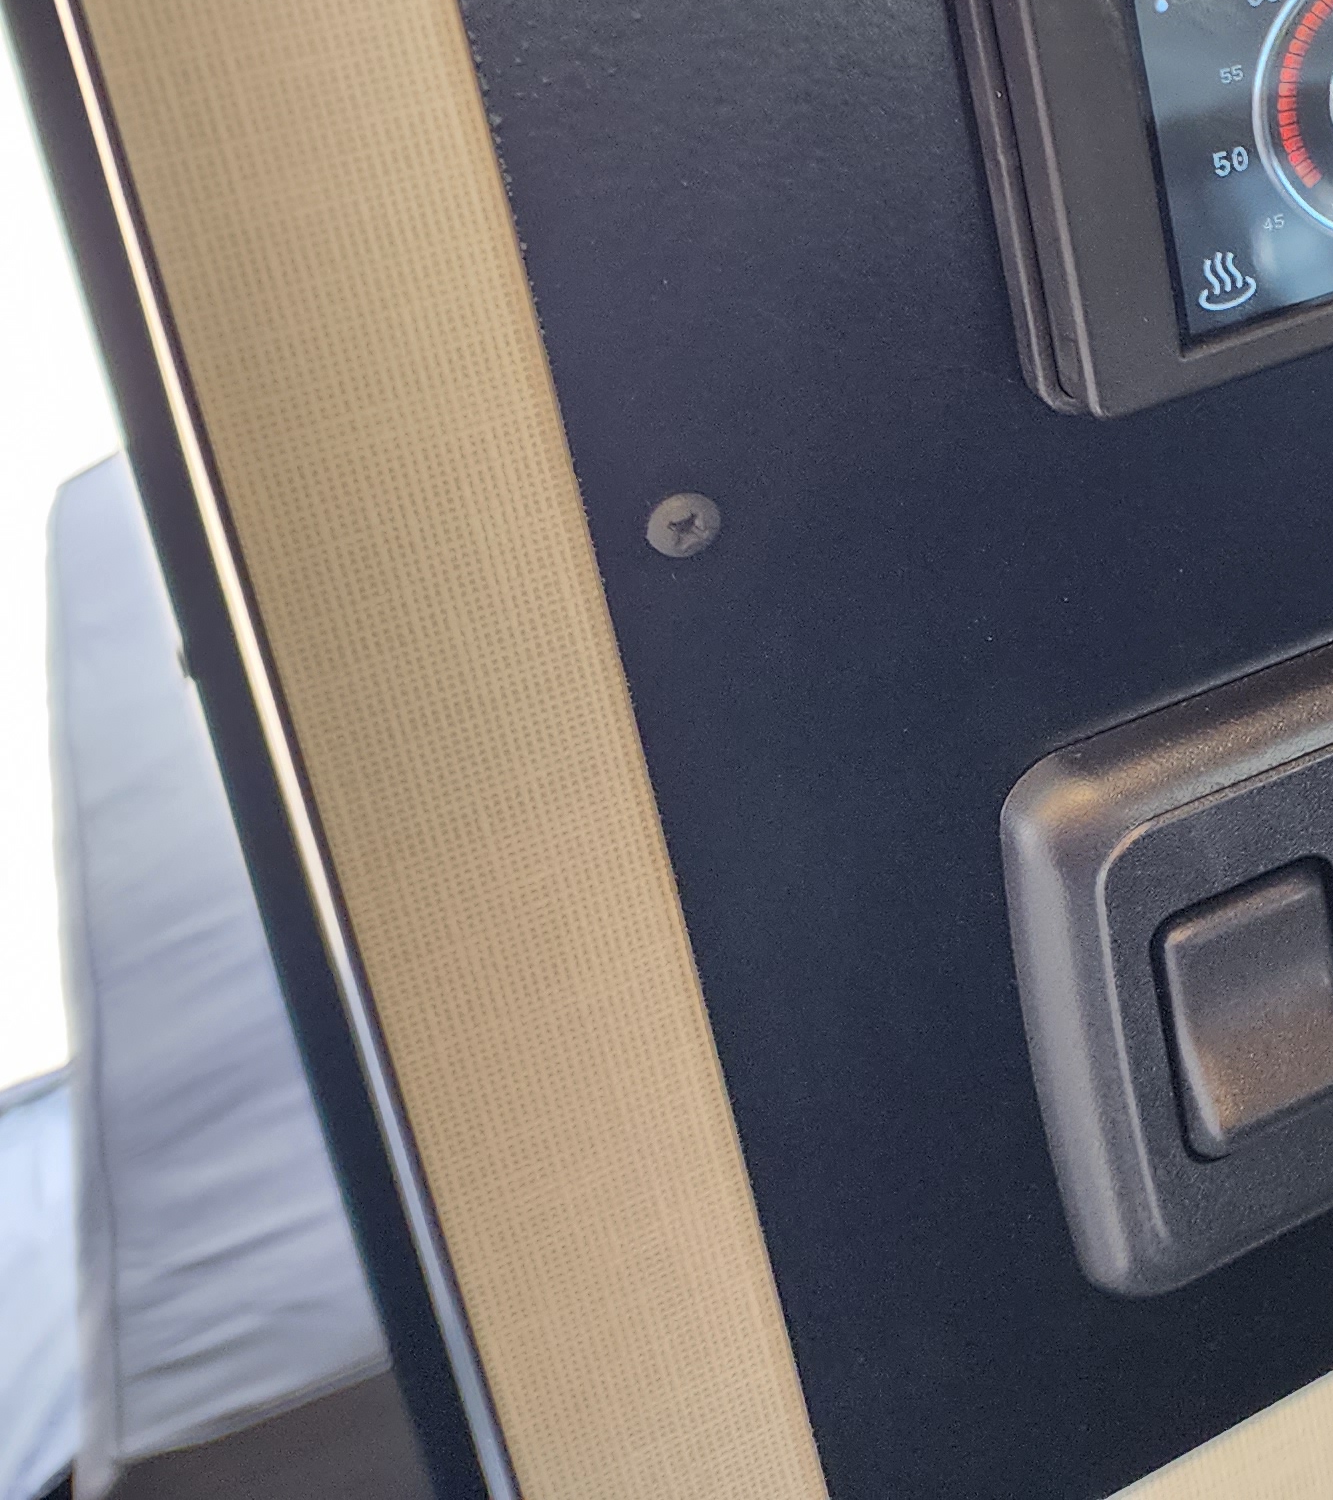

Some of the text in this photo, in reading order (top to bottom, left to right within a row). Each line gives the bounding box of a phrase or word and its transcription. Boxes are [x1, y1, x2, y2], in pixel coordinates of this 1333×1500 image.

[1219, 65, 1245, 84] 55
[1212, 146, 1250, 177] 50
[1261, 213, 1285, 232] 45
